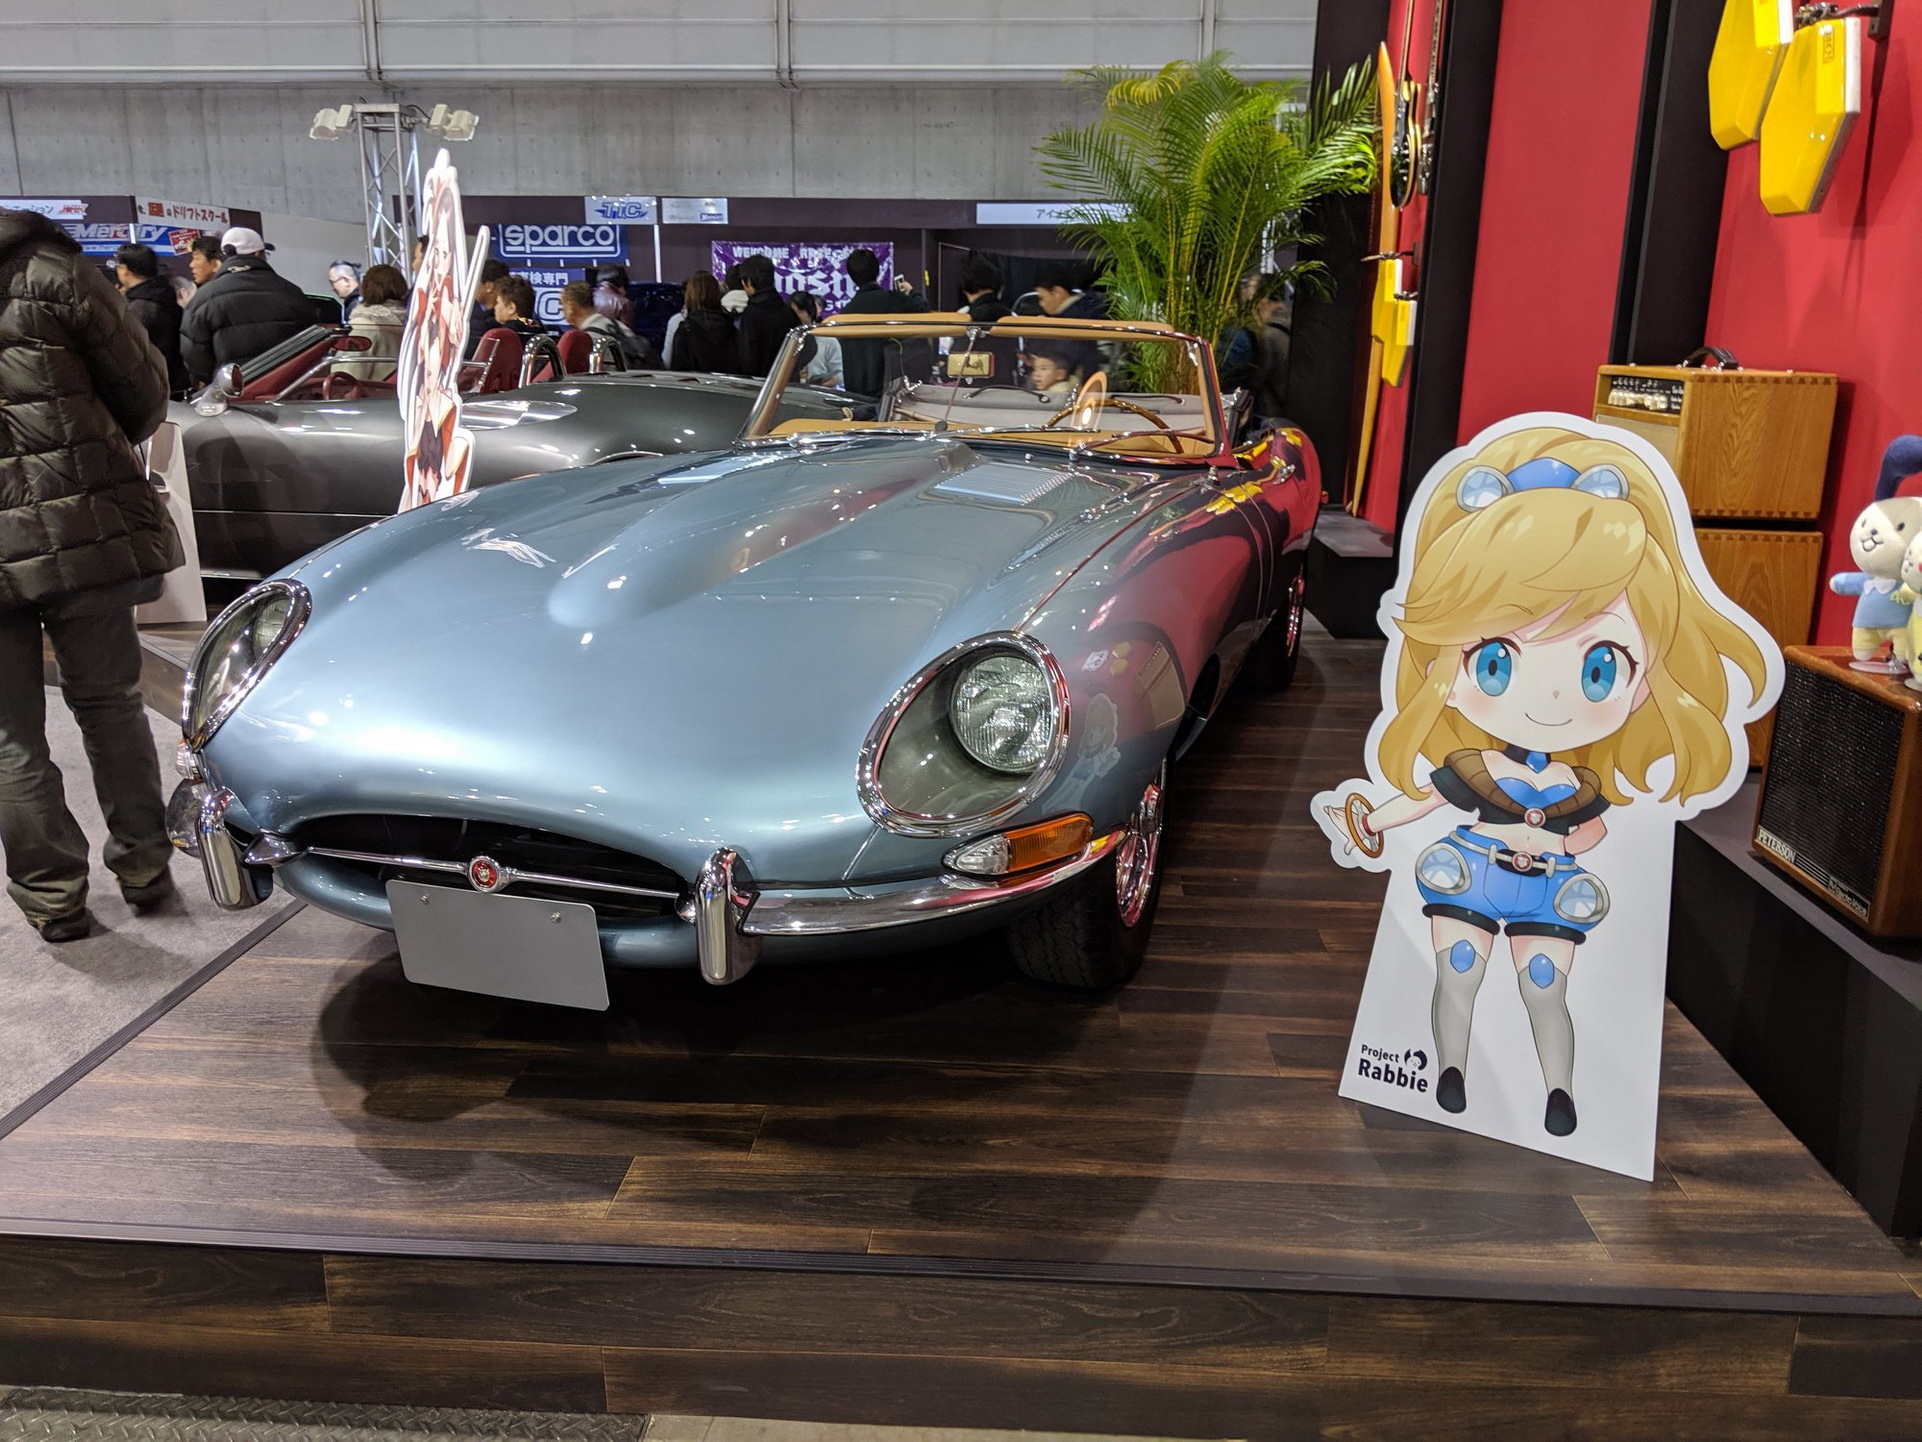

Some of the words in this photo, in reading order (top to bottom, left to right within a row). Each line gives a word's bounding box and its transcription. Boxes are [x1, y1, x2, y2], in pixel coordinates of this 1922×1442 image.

[504, 224, 615, 253] sparco
[1758, 828, 1797, 864] PETERSON
[1361, 1044, 1400, 1063] Project
[1358, 1057, 1428, 1093] Rabbie
